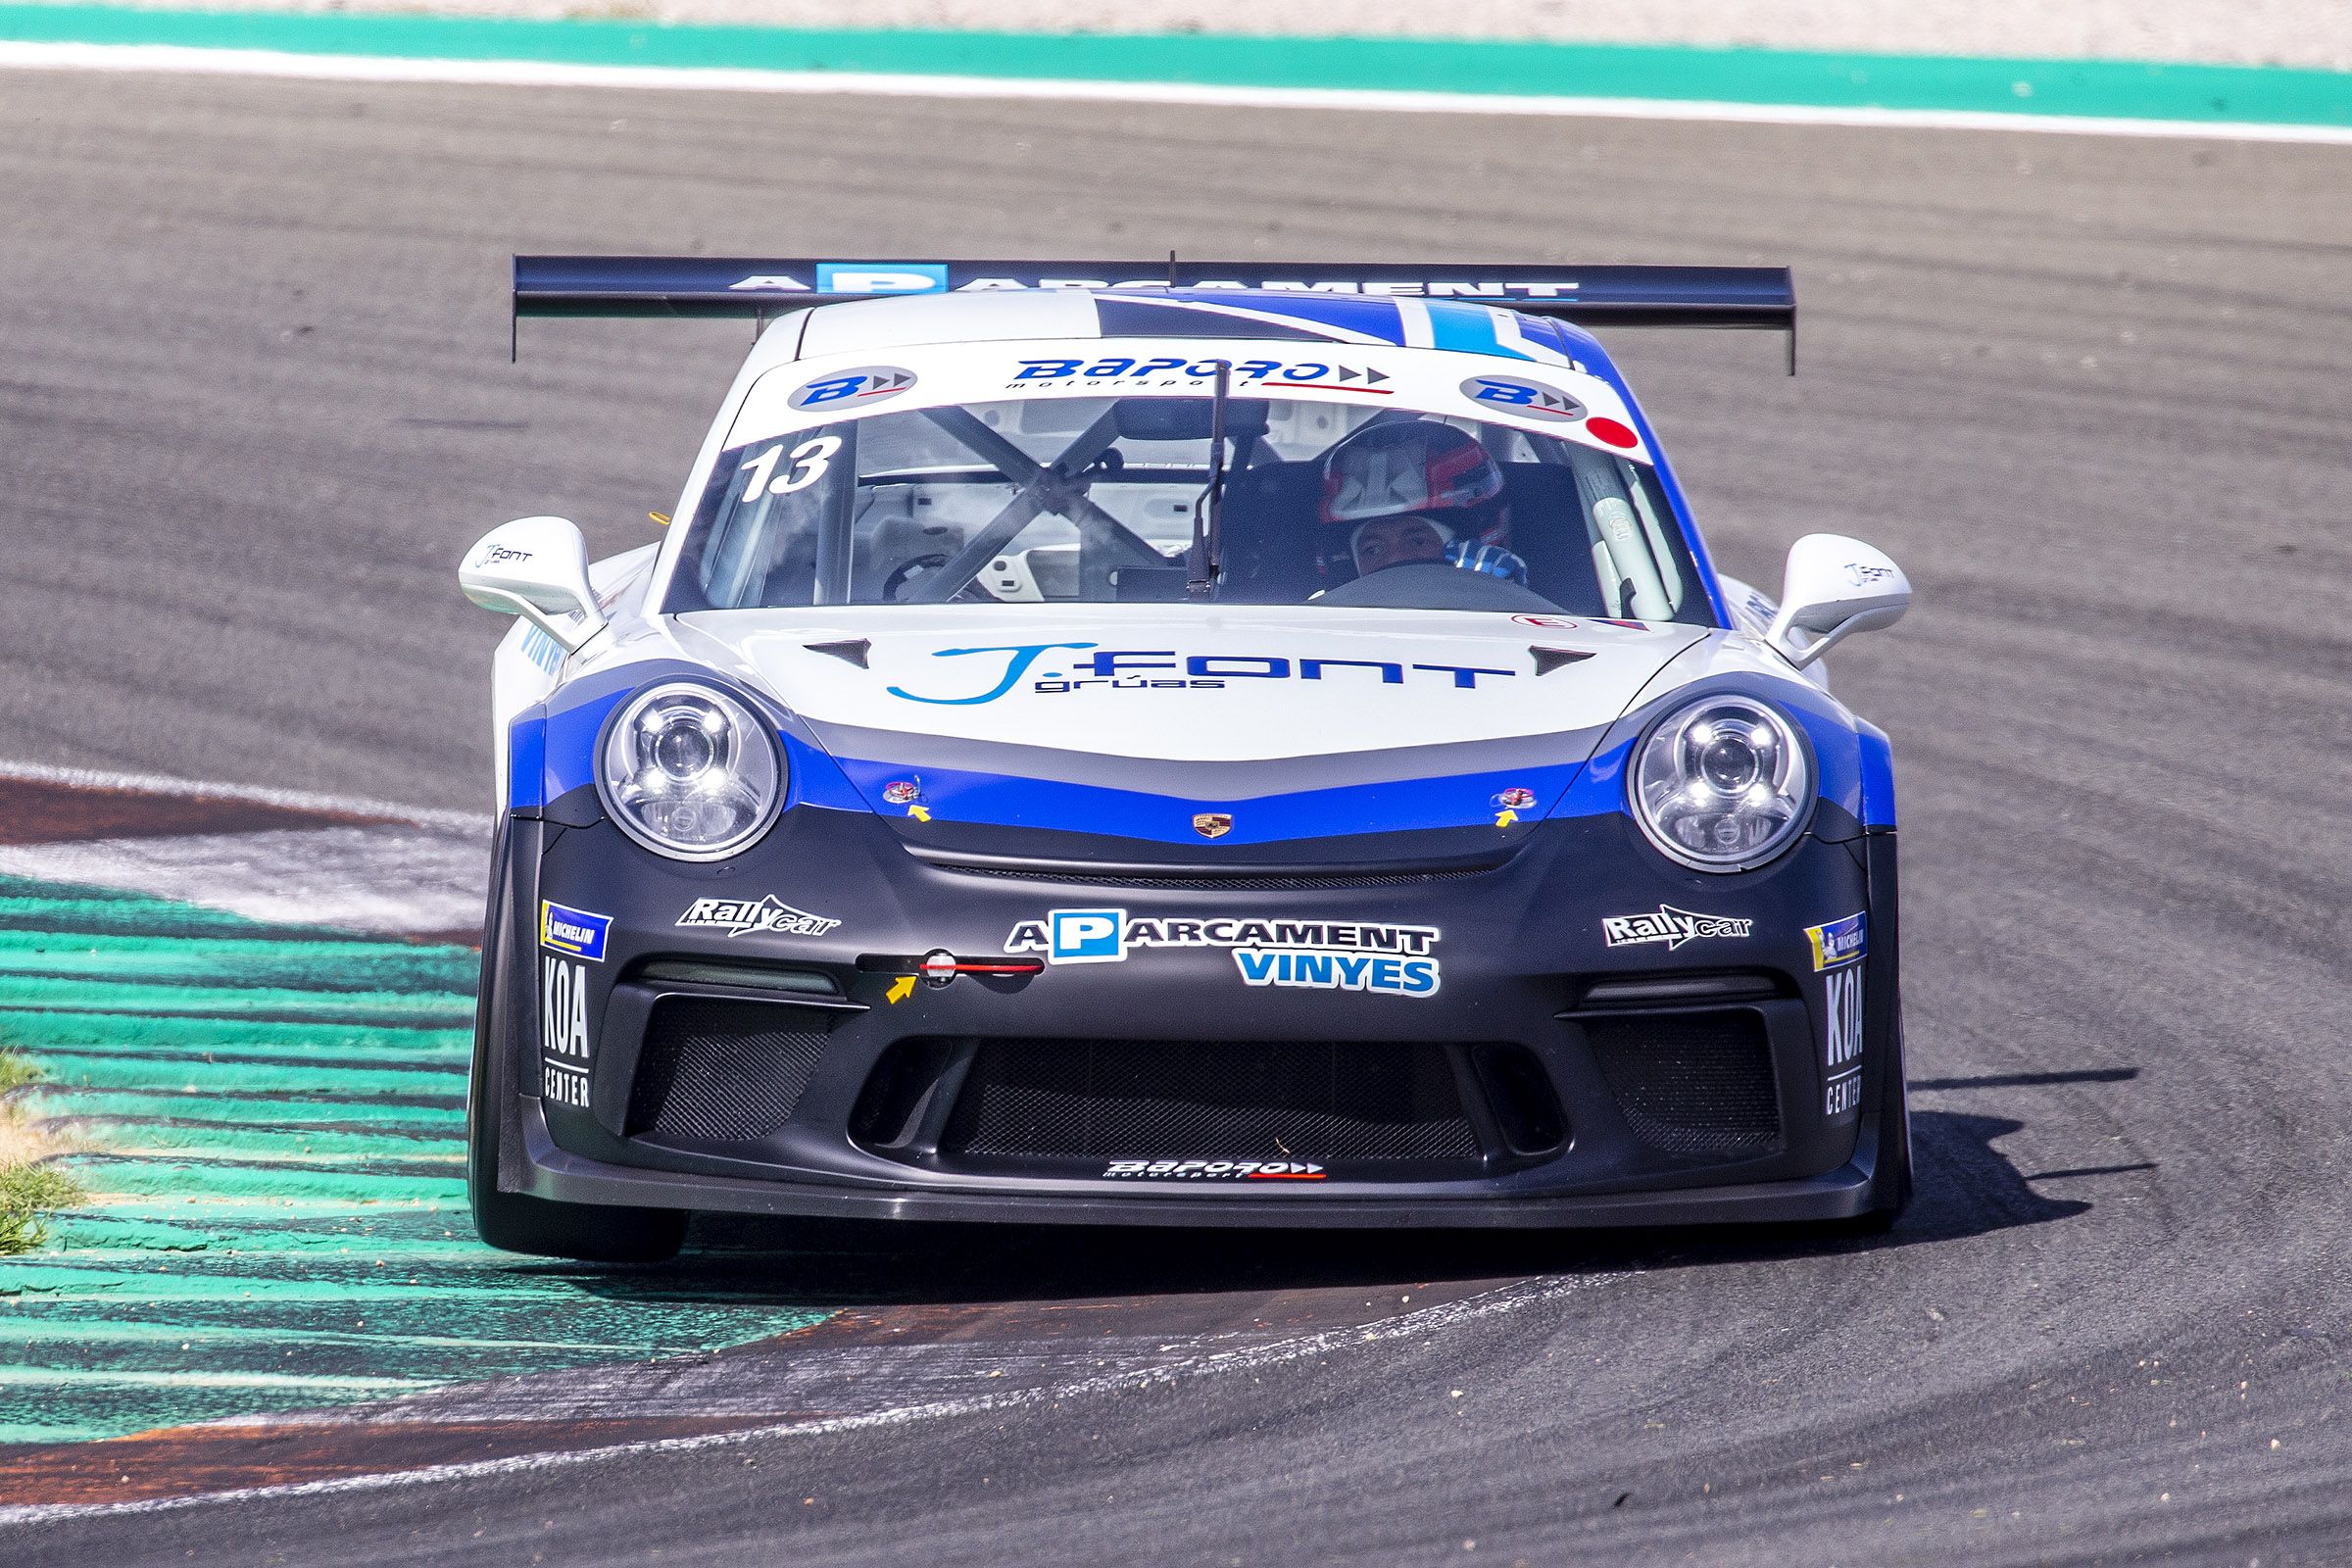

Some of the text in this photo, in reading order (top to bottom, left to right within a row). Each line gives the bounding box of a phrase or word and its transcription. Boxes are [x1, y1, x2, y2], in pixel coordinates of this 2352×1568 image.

[1005, 379, 1250, 389] motorspot
[741, 435, 842, 503] 13
[1035, 674, 1226, 694] grúas
[553, 920, 595, 945] MICHELIN
[688, 898, 842, 937] Rallycar
[1008, 914, 1435, 953] APARCAMENT
[1606, 911, 1753, 939] Rallycar
[1838, 929, 1864, 952] MICHELIN
[1237, 953, 1434, 994] VINYES
[544, 956, 590, 1058] KOA
[1826, 965, 1862, 1066] KOA
[544, 1066, 590, 1108] CENTER
[1827, 1075, 1861, 1115] CENTER
